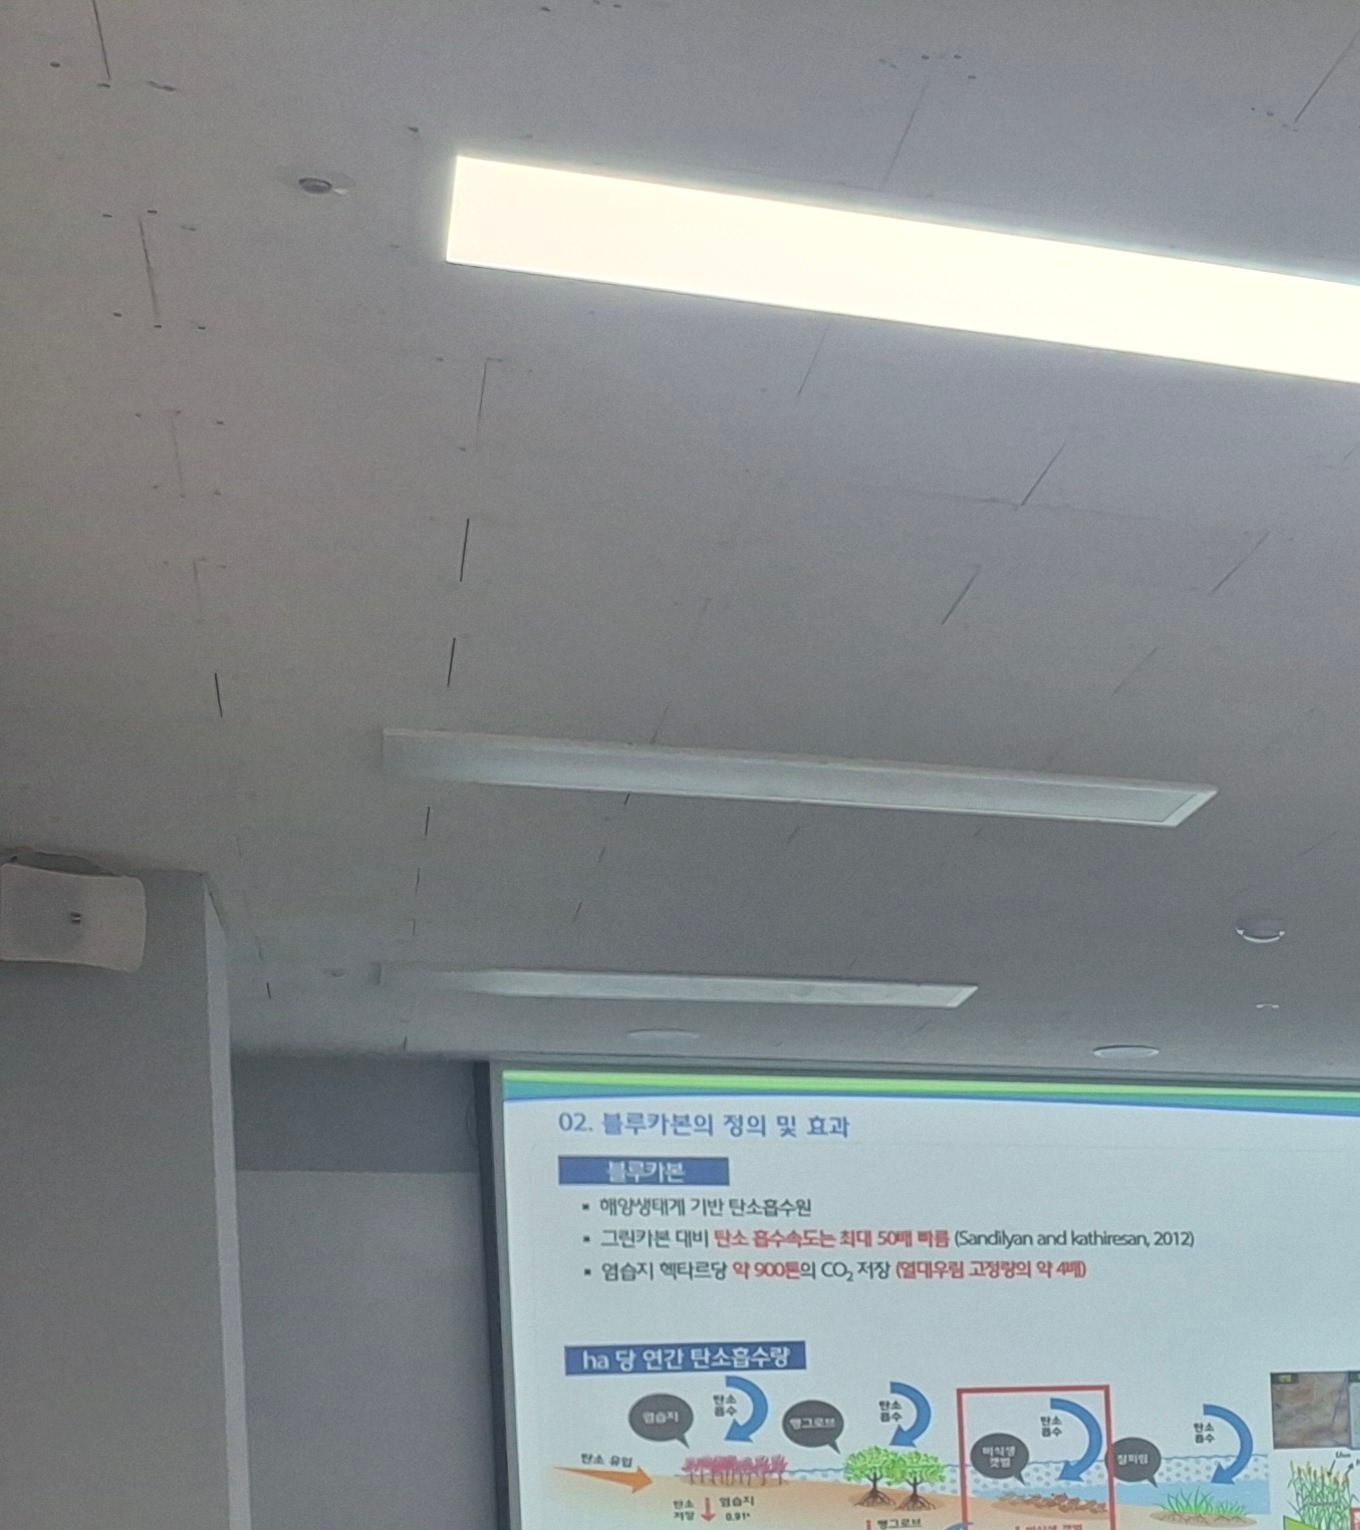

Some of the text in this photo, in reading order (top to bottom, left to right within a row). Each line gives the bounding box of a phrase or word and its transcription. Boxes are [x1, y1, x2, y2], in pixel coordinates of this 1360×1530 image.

[558, 1112, 850, 1138] 02. 블루카본의 정의 및 효과
[607, 1160, 685, 1184] 블루카본
[691, 1198, 724, 1217] 기반
[729, 1198, 812, 1218] 탄소흡수원
[600, 1229, 1195, 1250] 그린카본 대비 탄소 흡수속도는 최대 50배 빠름 (Sandilyan and kathiresan, 2012)
[602, 1261, 654, 1282] 염습지
[659, 1261, 728, 1281] 헥타르당
[732, 1262, 749, 1280] 약
[754, 1261, 816, 1281] 900톤의
[857, 1262, 891, 1282] 저장
[895, 1260, 965, 1280] (열대우림
[969, 1260, 1032, 1280] 고정량의
[1036, 1260, 1053, 1279] 약
[1055, 1260, 1087, 1279] 4배)
[582, 1346, 791, 1372] ha 당 연간 탄소흡수량
[712, 1394, 738, 1405] 탄소
[878, 1399, 903, 1410] 탄소
[642, 1411, 680, 1425] 염습지
[1039, 1415, 1063, 1426] 탄소
[1192, 1422, 1216, 1433] 탄소
[580, 1452, 634, 1468] 탄소 유입
[672, 1499, 696, 1510] 탄소
